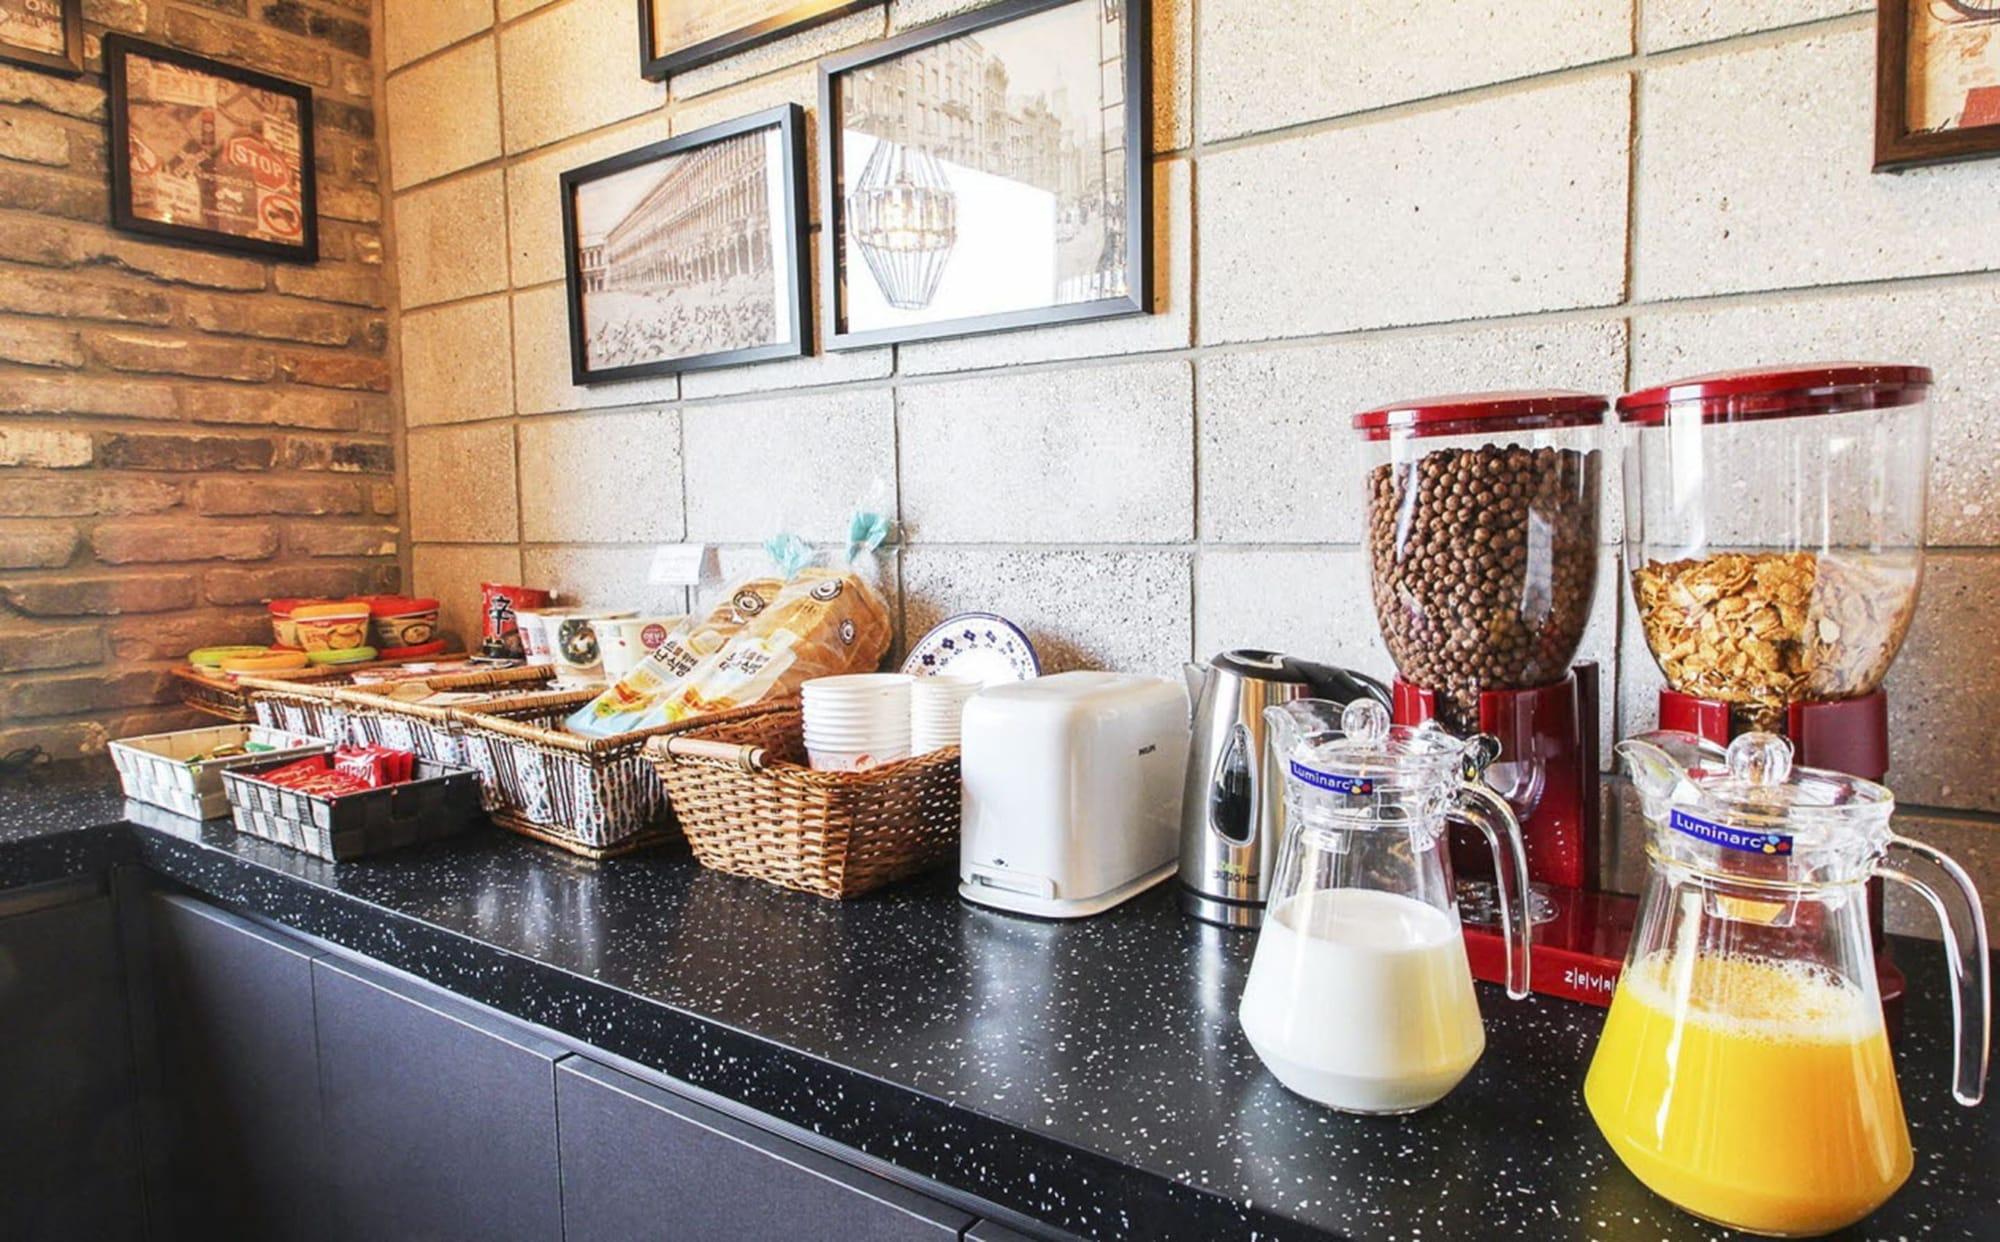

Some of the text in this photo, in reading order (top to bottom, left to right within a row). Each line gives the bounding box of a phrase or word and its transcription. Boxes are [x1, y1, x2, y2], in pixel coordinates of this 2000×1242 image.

[157, 73, 208, 97] EXIT
[234, 146, 284, 177] STOP
[1293, 762, 1351, 790] Luminarc
[1676, 814, 1761, 849] Luminarc
